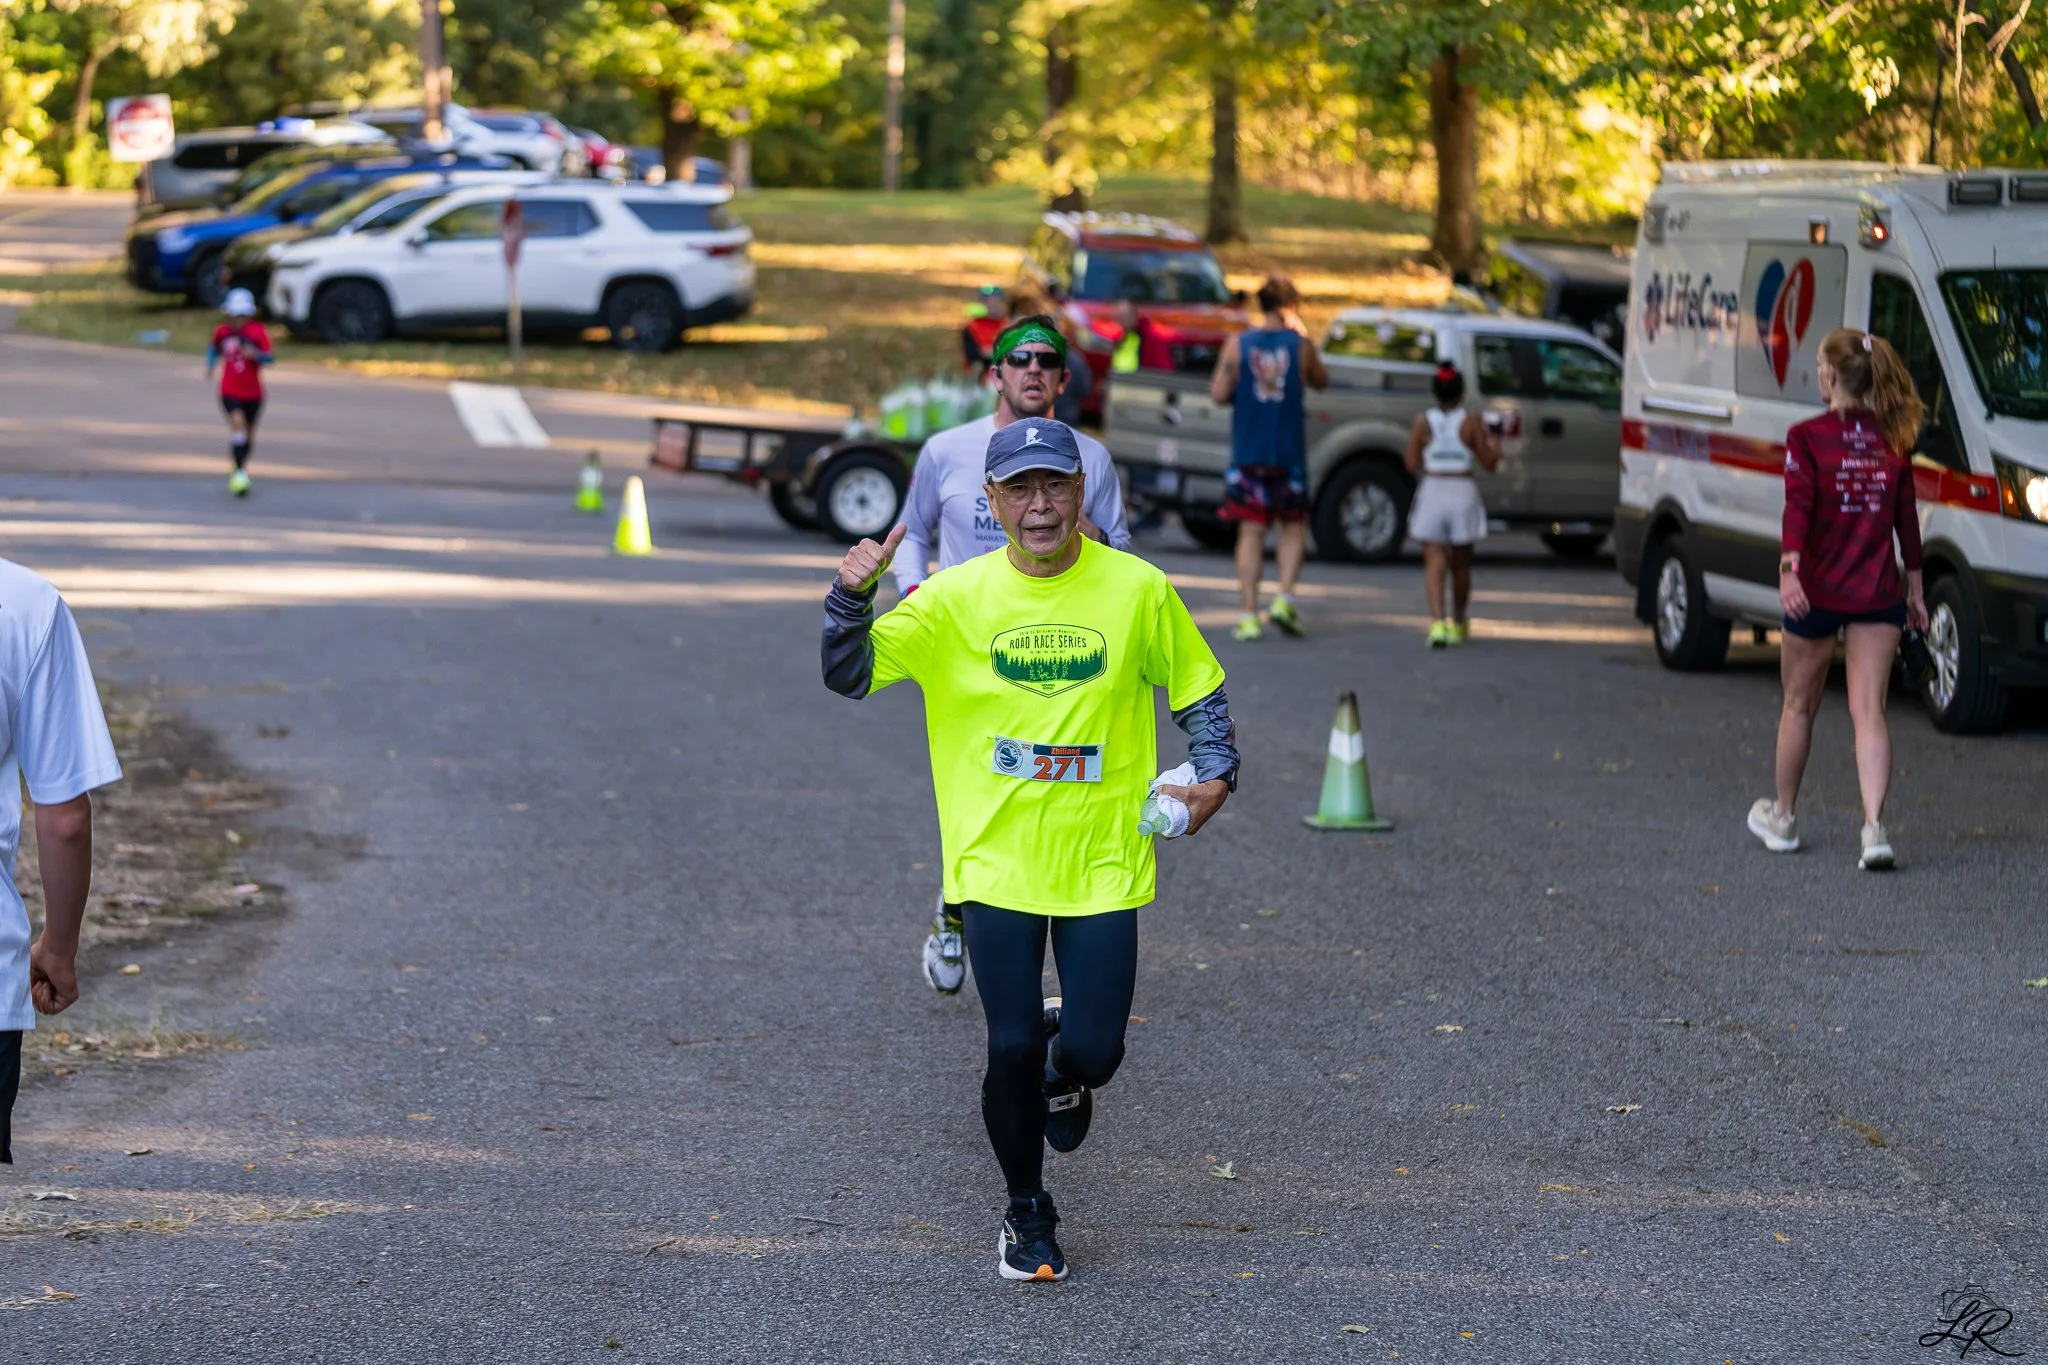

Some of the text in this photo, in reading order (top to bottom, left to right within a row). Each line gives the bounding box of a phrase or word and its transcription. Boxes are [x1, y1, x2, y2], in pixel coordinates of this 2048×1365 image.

[1665, 272, 1738, 329] LifeCare
[975, 497, 988, 512] S
[974, 515, 1003, 531] ME
[1010, 634, 1087, 649] ROAD RACE SERIES
[1051, 747, 1080, 756] Zhiliang
[1032, 756, 1086, 781] 271
